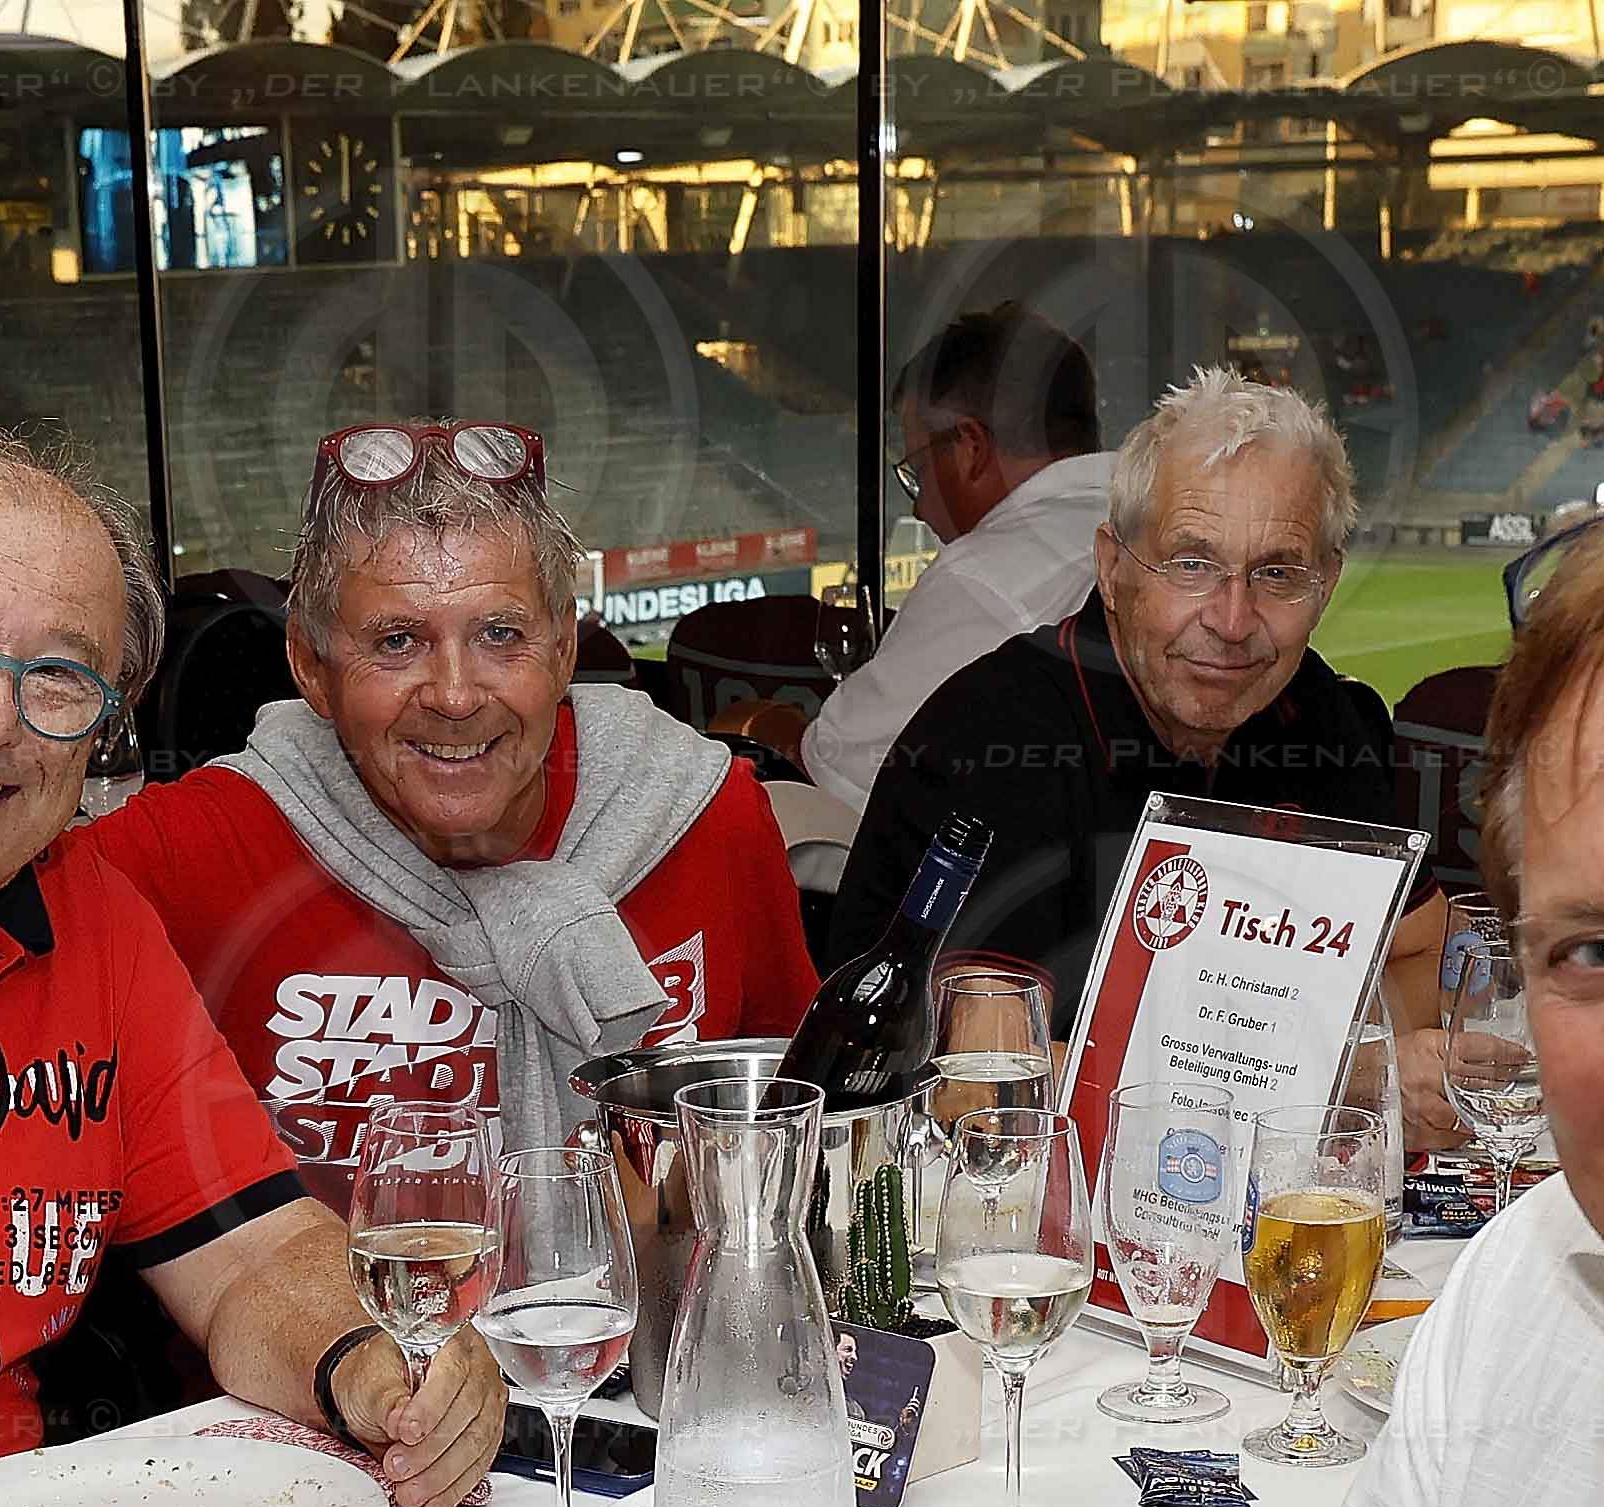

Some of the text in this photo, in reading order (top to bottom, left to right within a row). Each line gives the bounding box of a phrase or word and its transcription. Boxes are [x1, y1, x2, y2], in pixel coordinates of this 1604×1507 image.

[1220, 899, 1355, 958] Tisch 24
[1198, 969, 1300, 1001] Dr. H. Christandl 2
[1198, 1006, 1277, 1033] Dr. F. Gruber 1
[1160, 1035, 1298, 1077] Grosso Verwaltungs- und
[1169, 1055, 1278, 1091] Beteiligung GmbH 2
[1170, 1091, 1194, 1109] Foto
[1403, 1179, 1466, 1194] ADMIRA
[4, 1225, 18, 1249] 3
